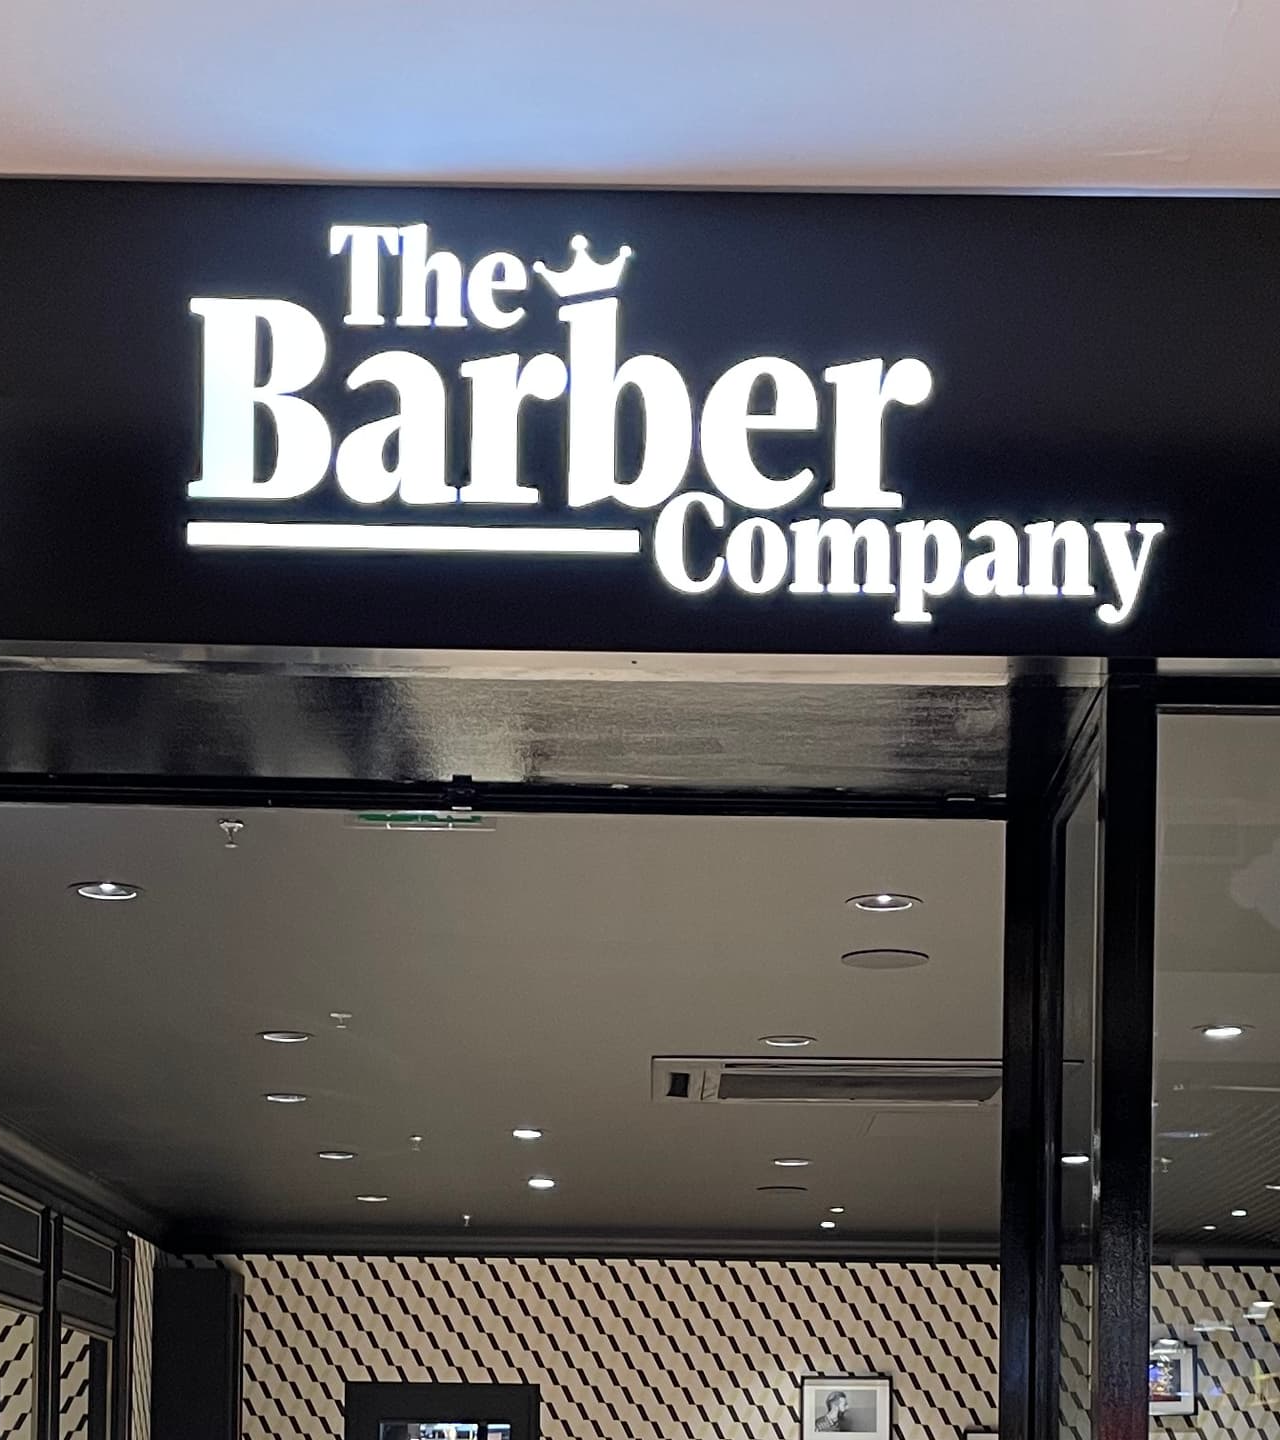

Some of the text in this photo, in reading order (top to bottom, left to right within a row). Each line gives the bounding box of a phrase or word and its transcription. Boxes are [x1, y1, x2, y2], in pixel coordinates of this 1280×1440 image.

[329, 222, 528, 329] The
[187, 295, 934, 510] Barber
[654, 490, 1165, 625] Company
